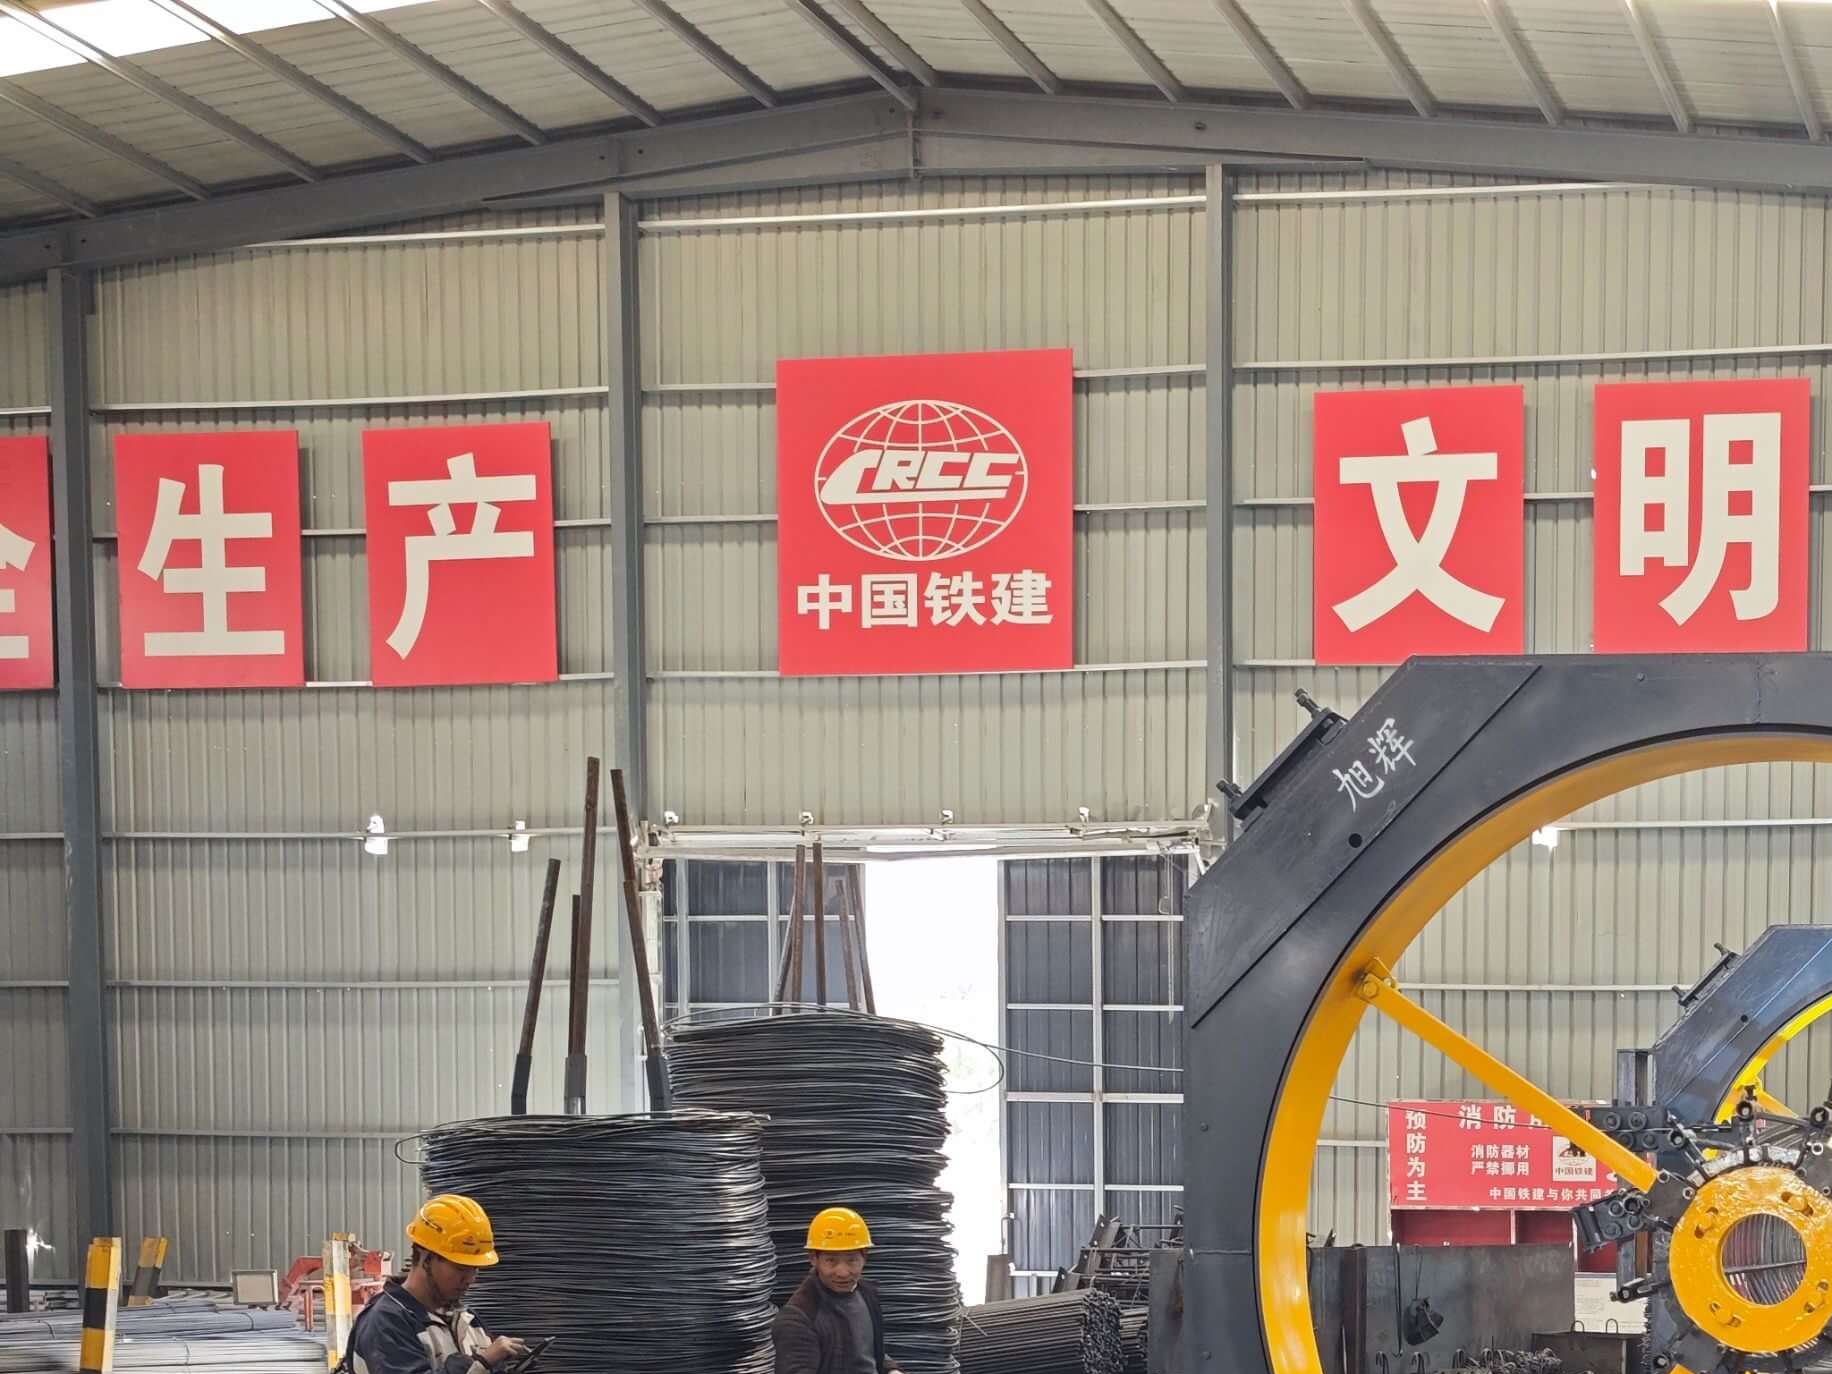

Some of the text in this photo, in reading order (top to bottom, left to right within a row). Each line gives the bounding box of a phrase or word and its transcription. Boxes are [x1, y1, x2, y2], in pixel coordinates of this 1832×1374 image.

[820, 449, 1020, 504] CRCC
[797, 569, 1053, 630] 中国铁建
[1332, 718, 1417, 813] 旭辉
[1405, 1109, 1427, 1201] 预防为主
[1471, 1144, 1530, 1159] 消防器材
[1471, 1161, 1530, 1176] 严禁挪用
